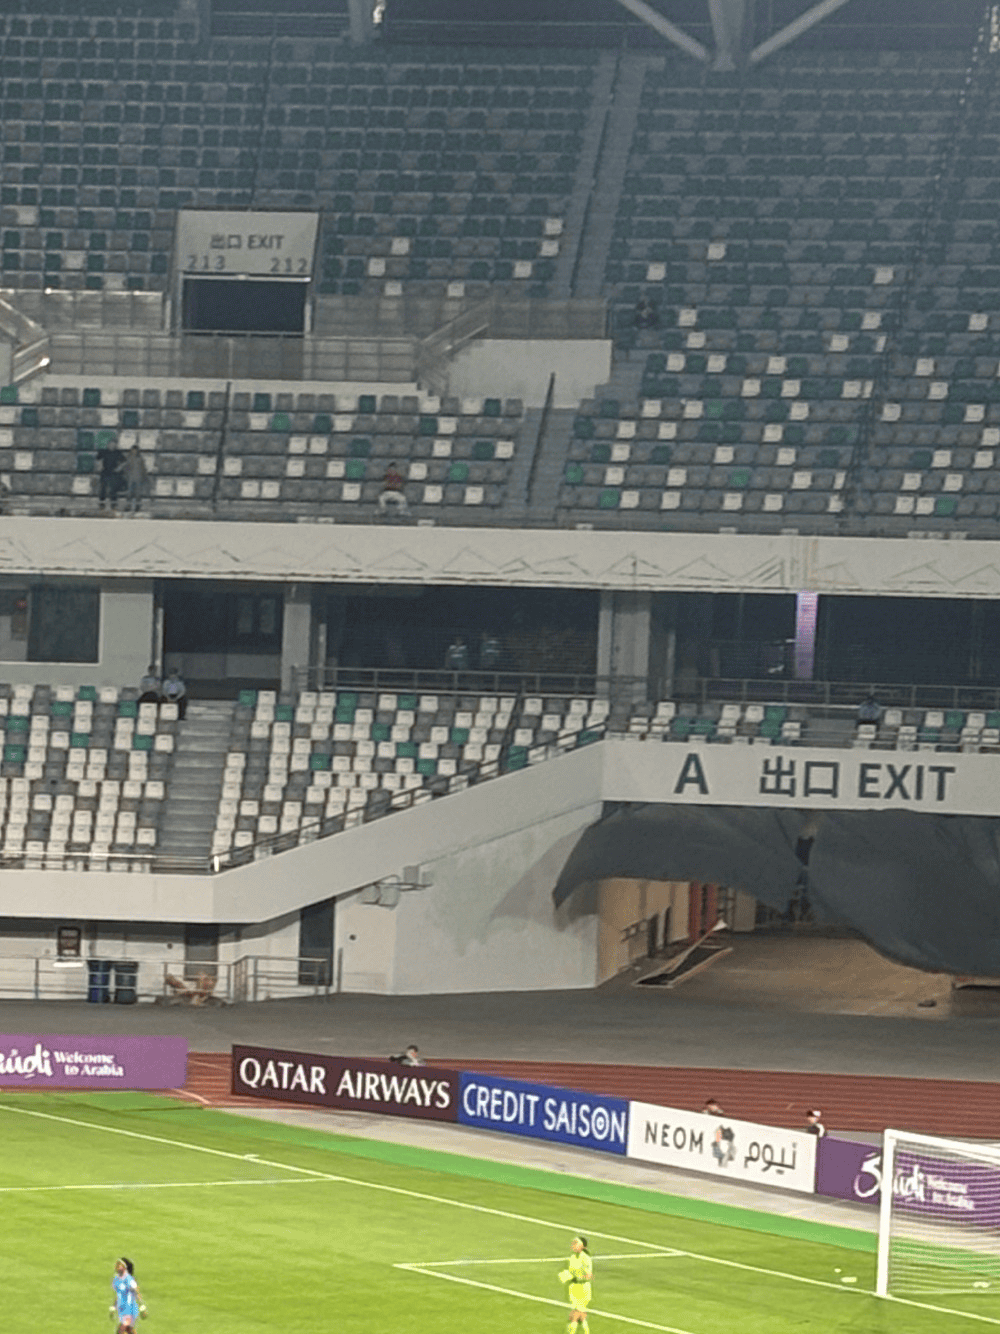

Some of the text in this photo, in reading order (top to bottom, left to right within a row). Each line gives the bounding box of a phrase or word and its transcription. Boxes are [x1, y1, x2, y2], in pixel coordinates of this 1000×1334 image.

[210, 233, 285, 250] 出口 EXIT
[187, 254, 226, 270] 213
[270, 257, 308, 273] 212
[673, 752, 956, 802] A 出口 EXIT
[53, 1050, 116, 1064] Welcome
[64, 1063, 125, 1077] to Arabia
[239, 1056, 451, 1109] QATAR AIRWAYS
[463, 1083, 626, 1144] CREDIT SAISON
[644, 1120, 704, 1154] NEOM
[744, 1141, 798, 1175] نيوم
[854, 1151, 925, 1202] Sudi
